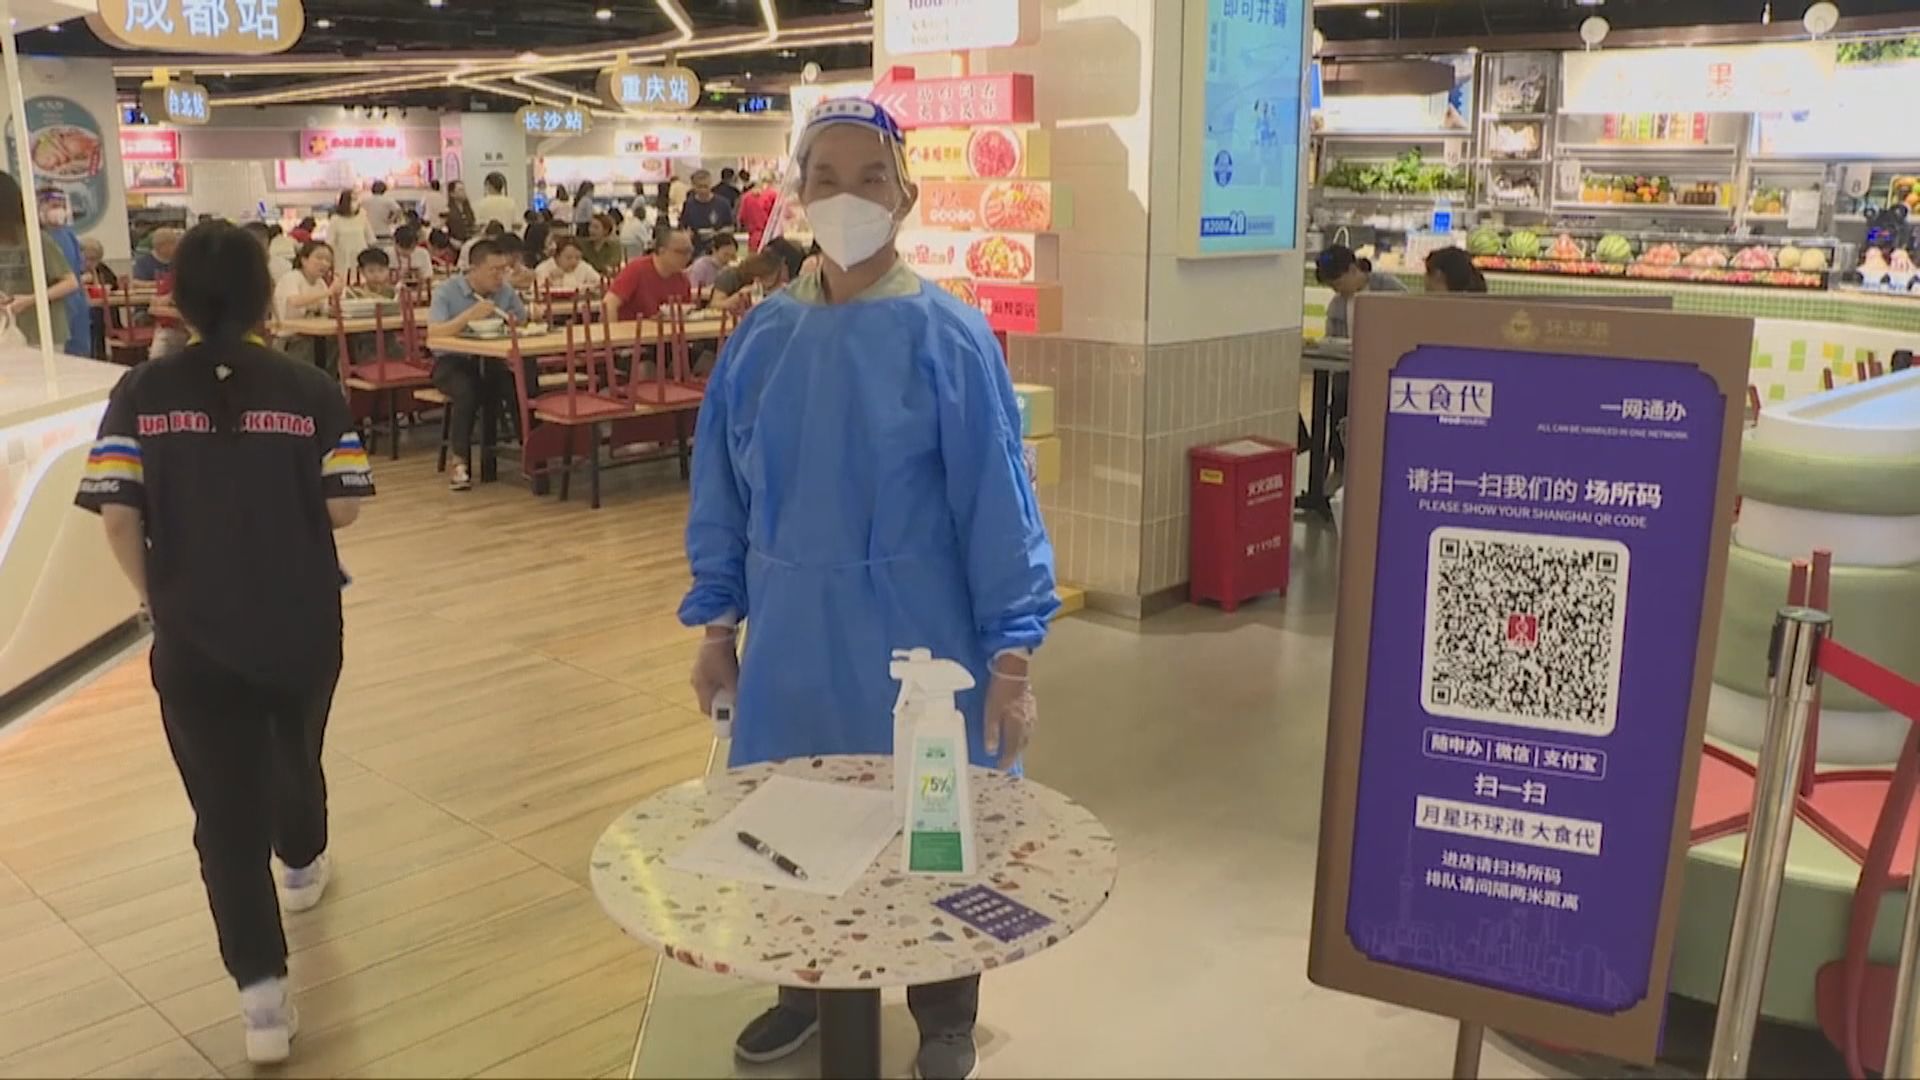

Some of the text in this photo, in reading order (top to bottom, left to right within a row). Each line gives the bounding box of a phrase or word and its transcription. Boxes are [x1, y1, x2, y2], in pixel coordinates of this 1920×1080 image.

[124, 0, 280, 39] 成都站
[622, 74, 689, 104] 重庆站
[523, 111, 582, 134] 长沙站
[1394, 382, 1487, 412] 大食代
[1600, 398, 1686, 422] 一网通办
[1537, 424, 1688, 440] ALL CAN BE HANDLED IN ONE NETWORK
[1407, 468, 1662, 509] 请扫一扫我们的 场所码
[1419, 499, 1647, 528] PLEASE SHOW YOUR SHANGHAI QR CODE
[1431, 734, 1598, 772] 随申办 微信 支付宝
[1474, 772, 1547, 805] 扫一扫
[1422, 804, 1596, 849] 月星环球港 大食代
[1441, 849, 1561, 885] 进店请扫场所码
[1426, 869, 1580, 912] 排队请间隔两米距离
